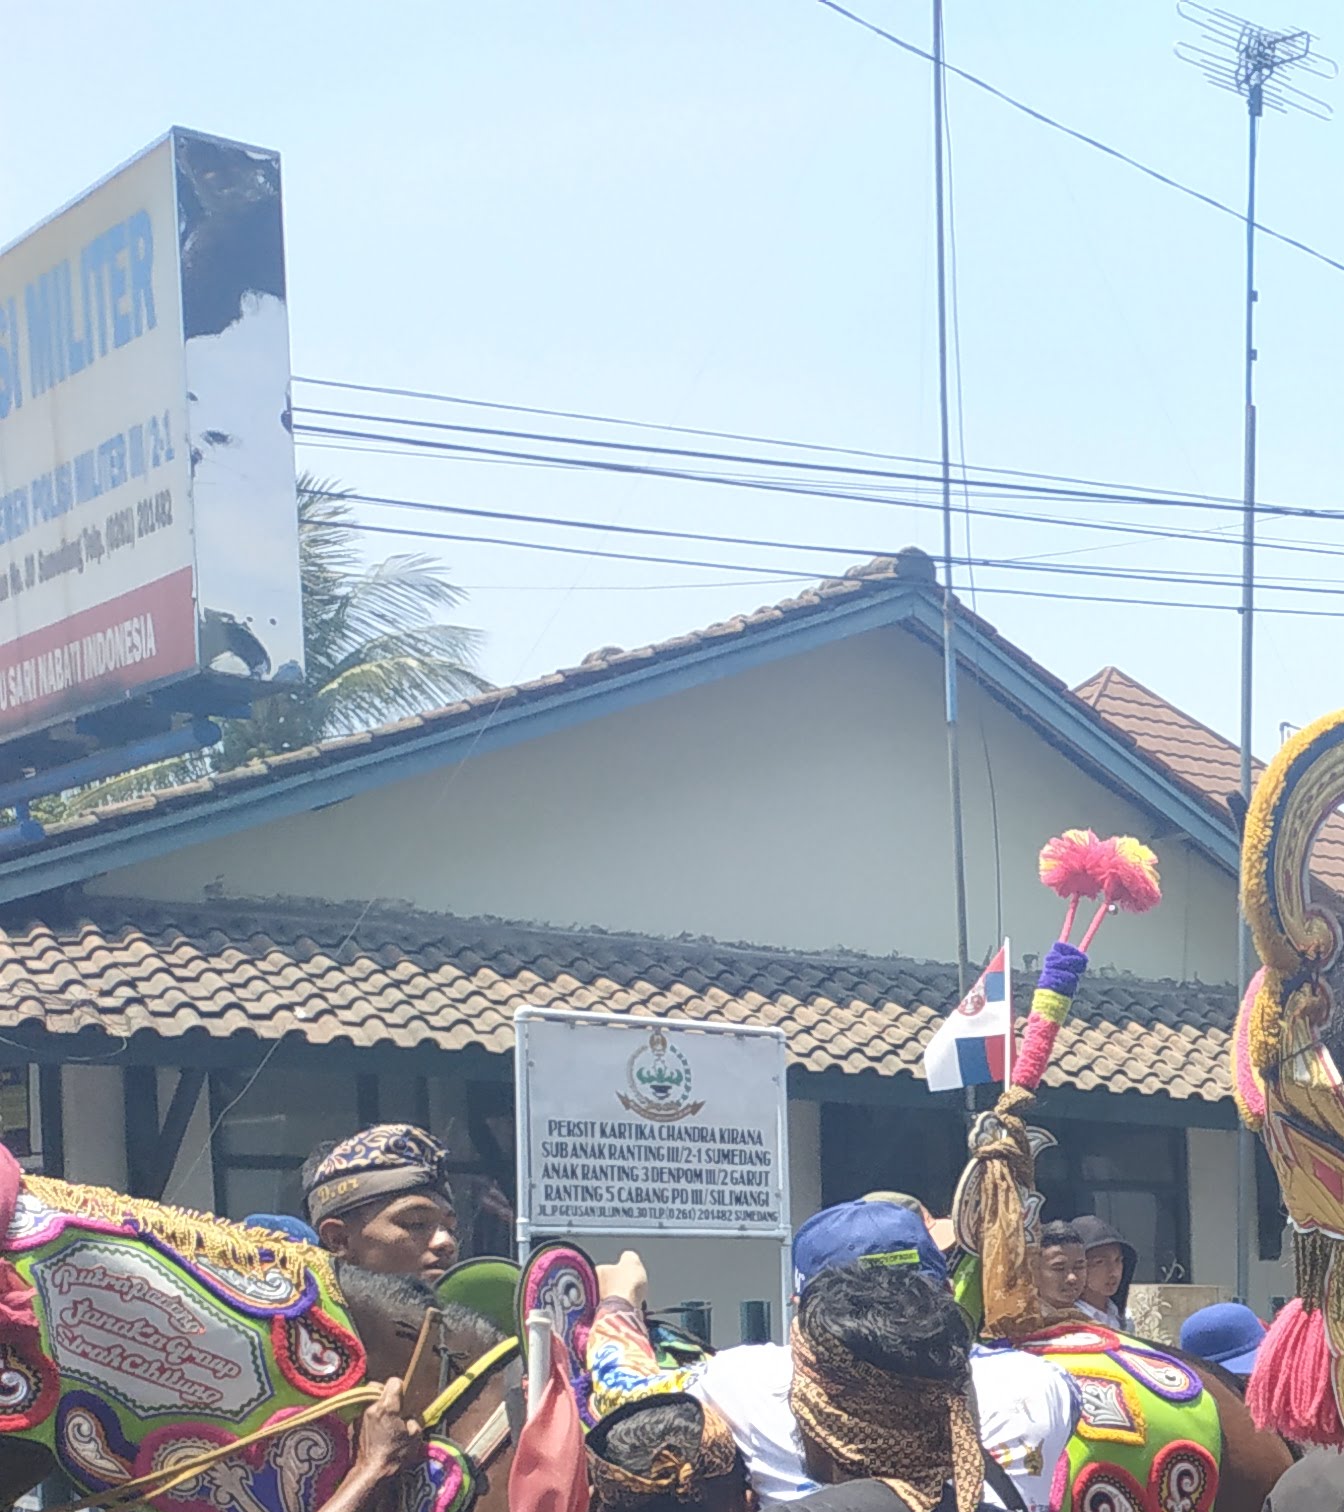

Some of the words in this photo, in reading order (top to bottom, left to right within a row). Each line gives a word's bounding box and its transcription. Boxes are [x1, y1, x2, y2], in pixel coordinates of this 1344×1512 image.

[24, 208, 157, 399] MILITER
[8, 658, 38, 708] SARI
[38, 640, 82, 697] NABATI
[82, 612, 157, 681] INDONESIA
[547, 1119, 597, 1138] PERSIT
[599, 1121, 657, 1141] KARTIKA
[658, 1124, 717, 1144] CHANDRA
[719, 1127, 764, 1147] KIRANA
[541, 1141, 568, 1159] SUB
[569, 1142, 606, 1160] ANAK
[608, 1143, 665, 1162] RANTING
[704, 1147, 772, 1167] SUMEDANG
[541, 1162, 579, 1180] ANAK
[581, 1163, 640, 1182] RANTING
[641, 1165, 649, 1183] 3
[651, 1166, 704, 1185] DENPOM
[730, 1169, 771, 1188] GARUT
[544, 1184, 604, 1203] RANTING
[605, 1185, 616, 1203] 5
[617, 1186, 670, 1205] CABANG
[671, 1187, 689, 1206] PD
[734, 1209, 778, 1223] SUMEDANG
